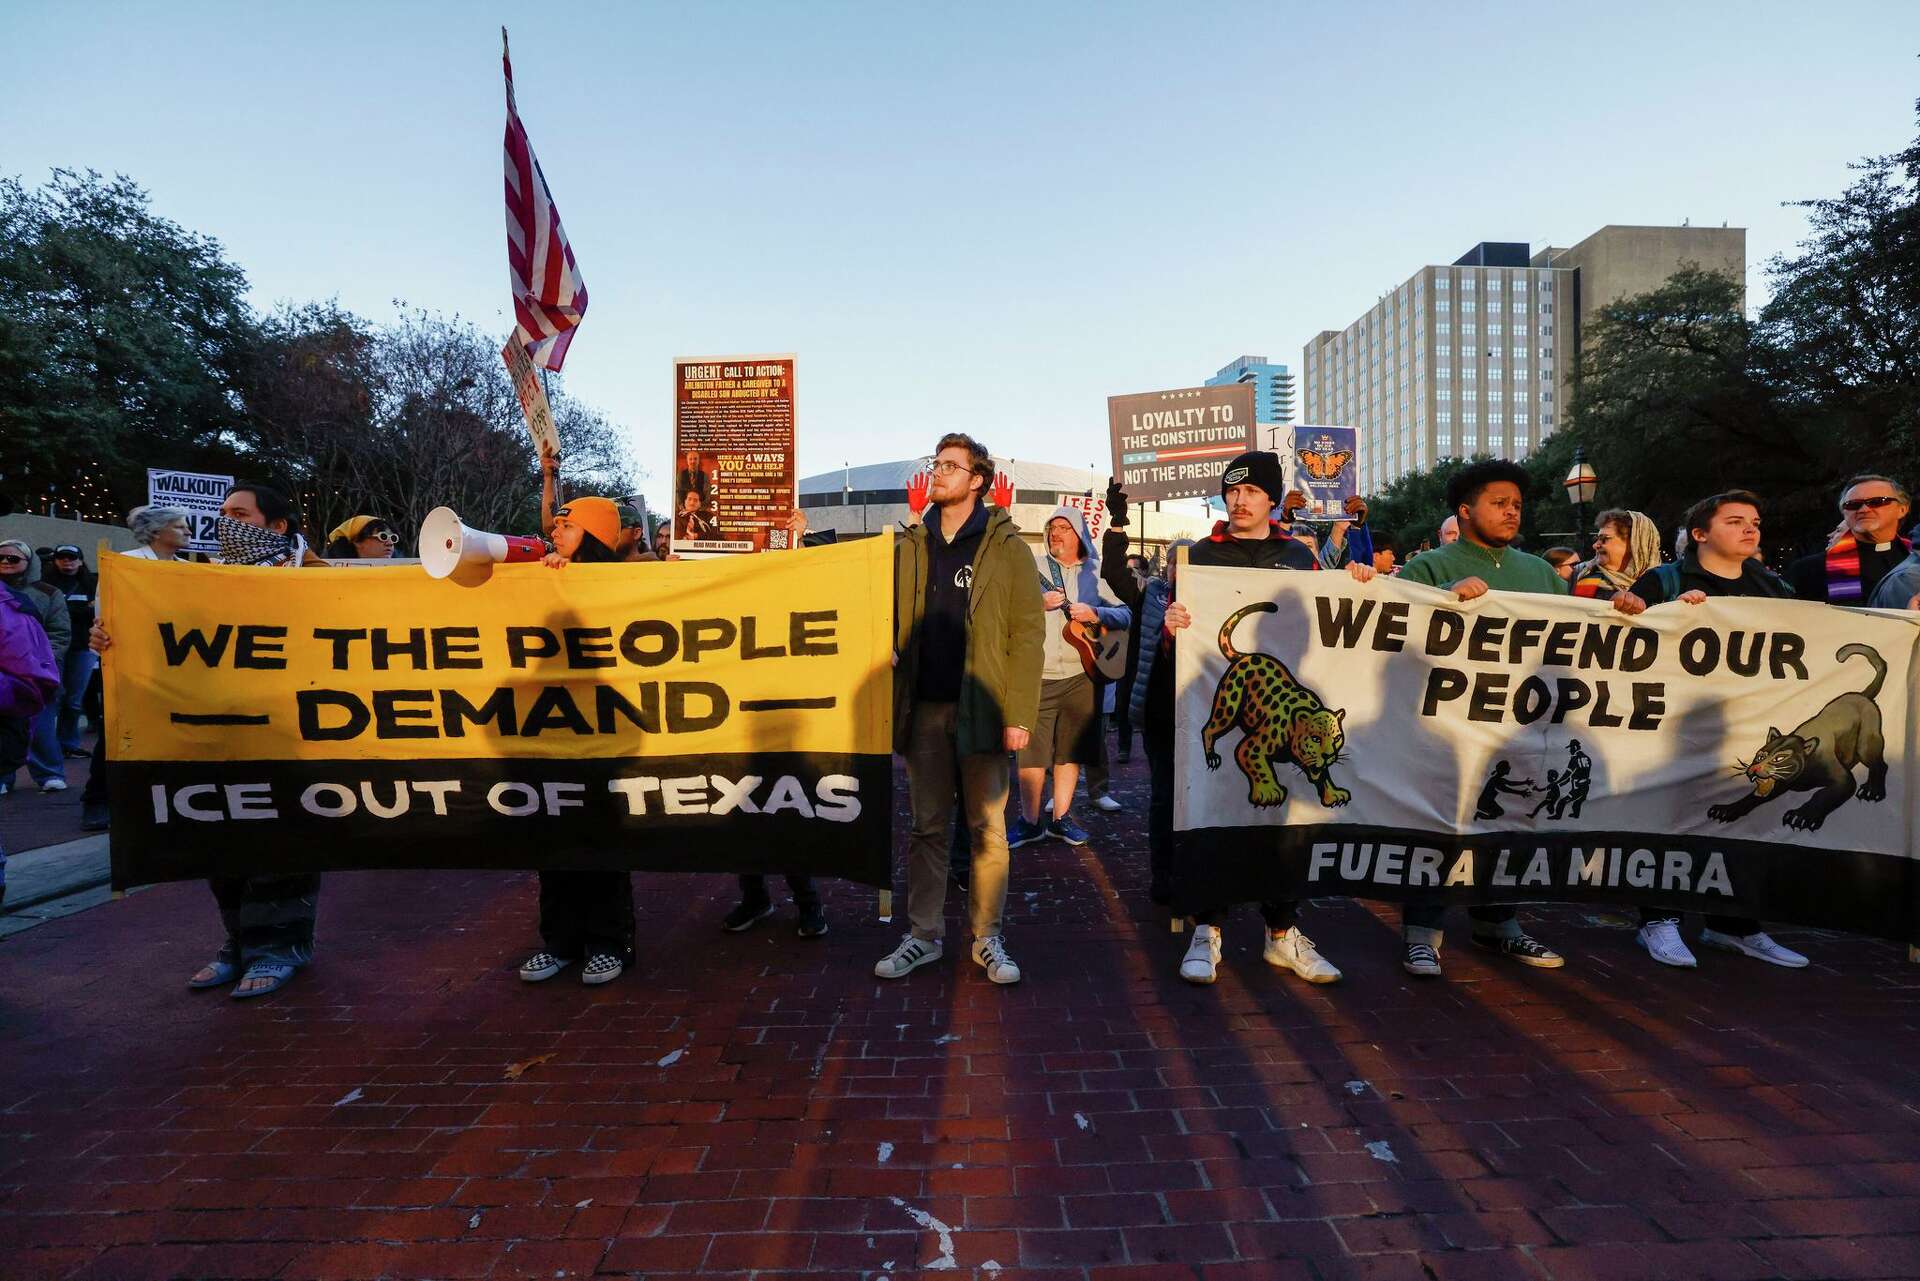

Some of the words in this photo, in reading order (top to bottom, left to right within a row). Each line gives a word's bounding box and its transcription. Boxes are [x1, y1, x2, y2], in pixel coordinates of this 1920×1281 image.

[684, 365, 722, 379] URGENT
[724, 366, 743, 378] CALL
[744, 366, 754, 377] TO
[756, 365, 785, 377] ACTION:
[715, 381, 736, 389] FATHER
[742, 380, 772, 388] CAREGIVER
[692, 390, 718, 399] DISABLED
[719, 390, 730, 398] SON
[731, 389, 759, 398] ABDUCTED
[760, 389, 768, 397] BY
[770, 388, 779, 397] ICE
[1132, 407, 1206, 431] LOYALTY
[1210, 405, 1234, 423] TO
[1122, 435, 1149, 449] THE
[1152, 425, 1246, 447] CONSTITUTION
[745, 454, 751, 462] 4
[752, 454, 785, 462] WAYS
[718, 461, 744, 470] YOU
[1124, 468, 1149, 485] NOT
[1151, 466, 1176, 482] THE
[1179, 460, 1230, 480] PRESIDE
[711, 470, 718, 480] 1
[711, 485, 719, 495] 2
[153, 495, 221, 506] NATIONWID
[711, 501, 718, 511] 3
[710, 516, 718, 527] 4
[157, 622, 288, 669] WE
[313, 626, 483, 670] THE
[506, 610, 838, 669] PEOPLE
[1315, 596, 1410, 653] WE
[1425, 609, 1659, 672] DEFEND
[1679, 627, 1809, 680] OUR
[1422, 667, 1665, 730] PEOPLE
[296, 681, 730, 740] DEMAND
[151, 783, 279, 823] ICE
[300, 780, 462, 818] OUT
[486, 782, 586, 816] OF
[608, 774, 862, 823] TEXAS
[1307, 842, 1475, 887] FUERA
[1491, 848, 1552, 887] LA
[1567, 846, 1735, 897] MIGRA
